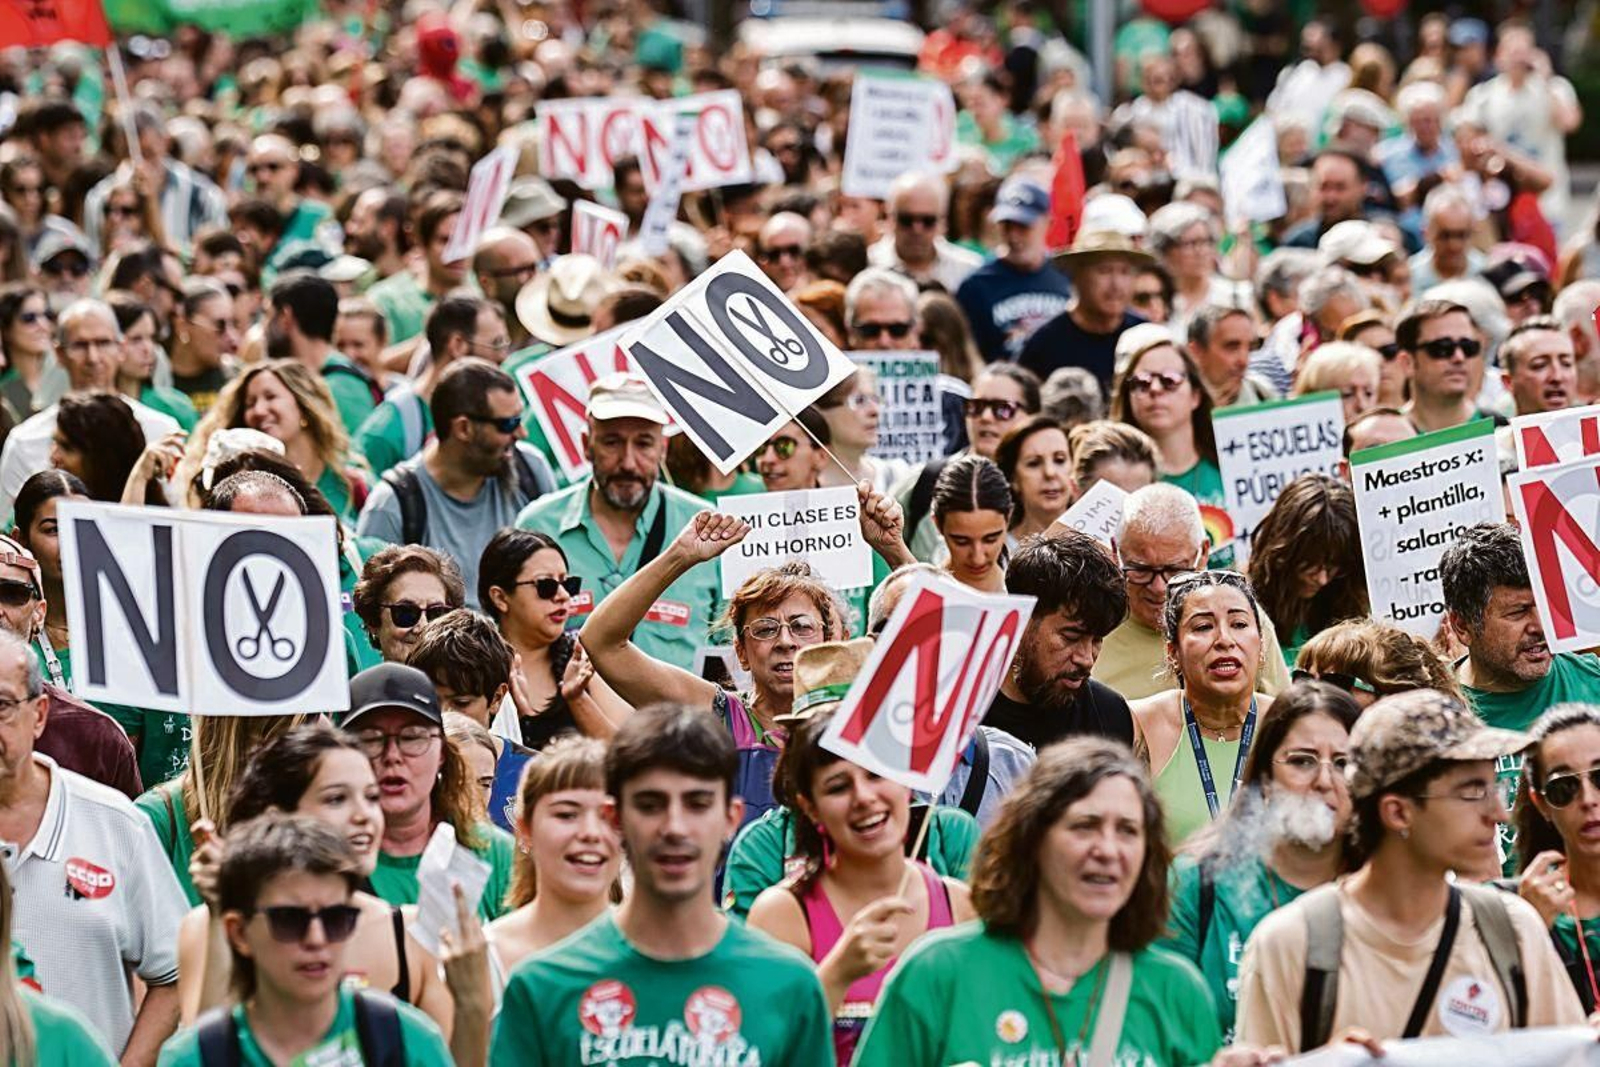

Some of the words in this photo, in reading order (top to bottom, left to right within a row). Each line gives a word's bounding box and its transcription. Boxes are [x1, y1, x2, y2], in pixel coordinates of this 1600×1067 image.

[628, 271, 830, 462] NO
[528, 345, 632, 468] N
[1248, 420, 1339, 461] ESCUELAS
[1364, 453, 1461, 492] Maestros
[1464, 448, 1485, 466] x:
[741, 513, 763, 530] MI
[767, 507, 829, 528] CLASE
[833, 504, 857, 521] ES
[1396, 482, 1486, 524] plantilla,
[741, 541, 769, 558] UN
[775, 532, 853, 556] HORNO!
[73, 517, 330, 705] NO
[840, 587, 1020, 775] NO
